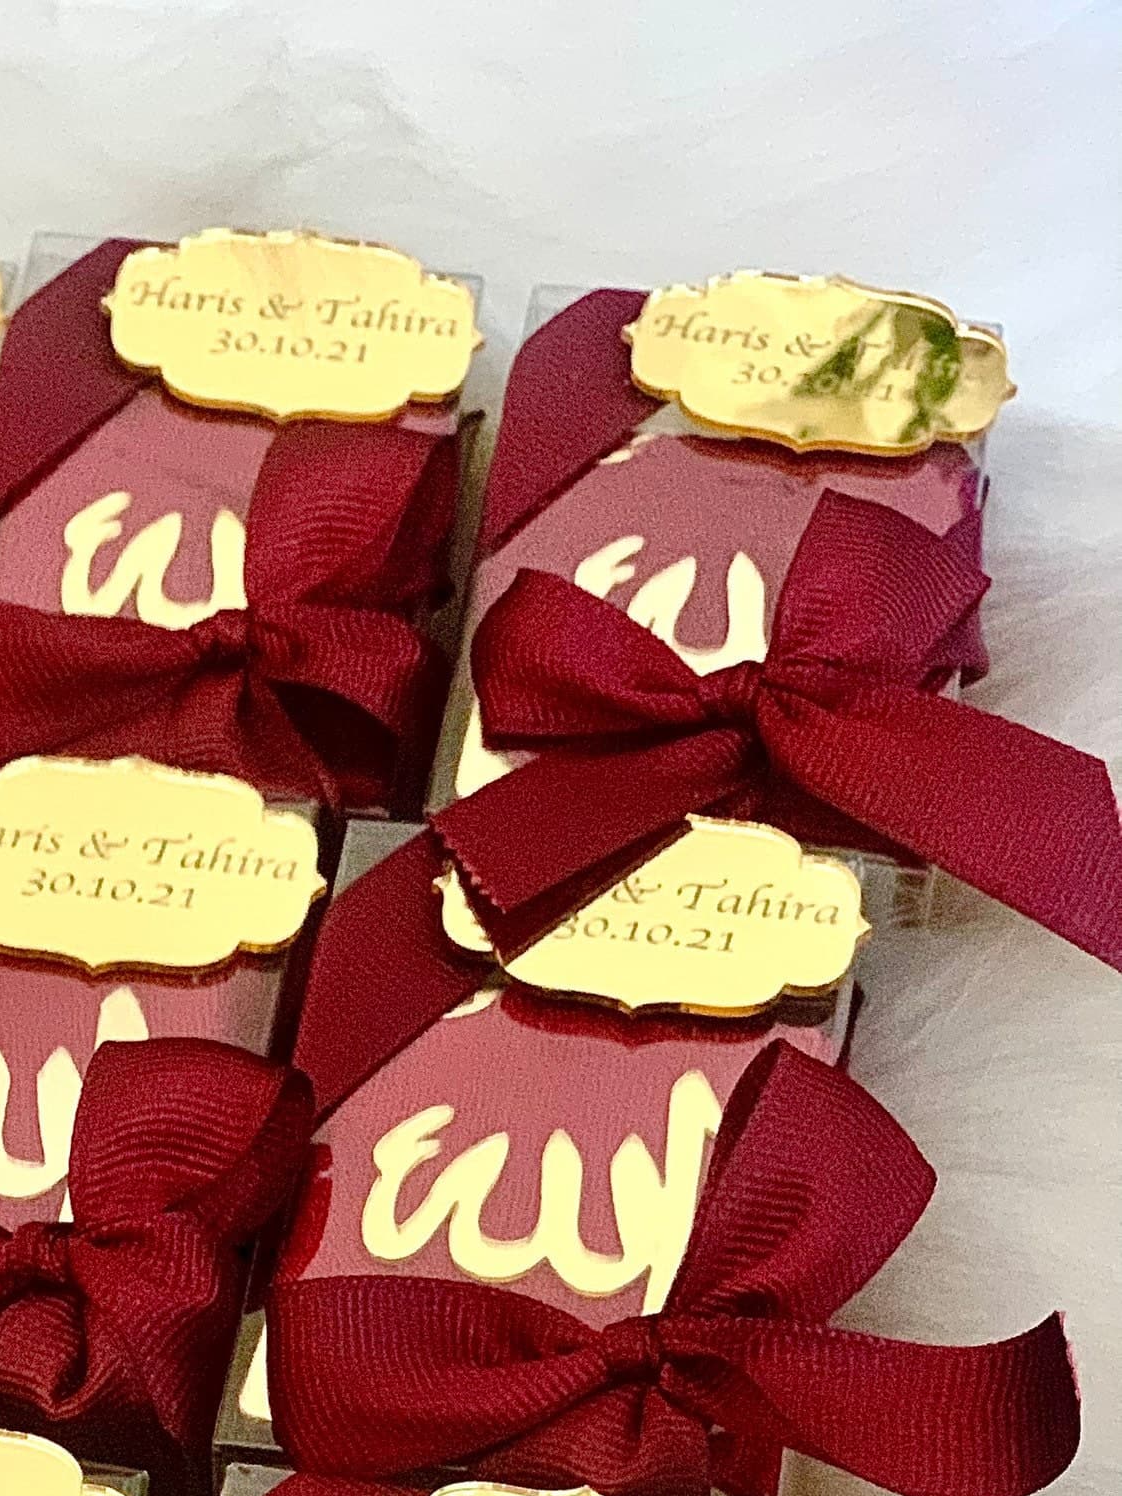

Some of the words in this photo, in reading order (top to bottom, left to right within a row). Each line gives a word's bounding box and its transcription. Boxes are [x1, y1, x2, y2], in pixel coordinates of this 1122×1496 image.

[131, 277, 242, 315] Haris
[259, 295, 302, 320] &
[316, 296, 457, 337] Tahira
[210, 329, 367, 361] 30.10.21
[654, 313, 770, 352] Haris
[785, 334, 830, 358] &
[79, 830, 128, 859] &
[142, 833, 298, 881] Tahira
[21, 867, 195, 908] 30.10.21
[677, 878, 839, 925] Tahira
[552, 915, 734, 952] 30.10.21
